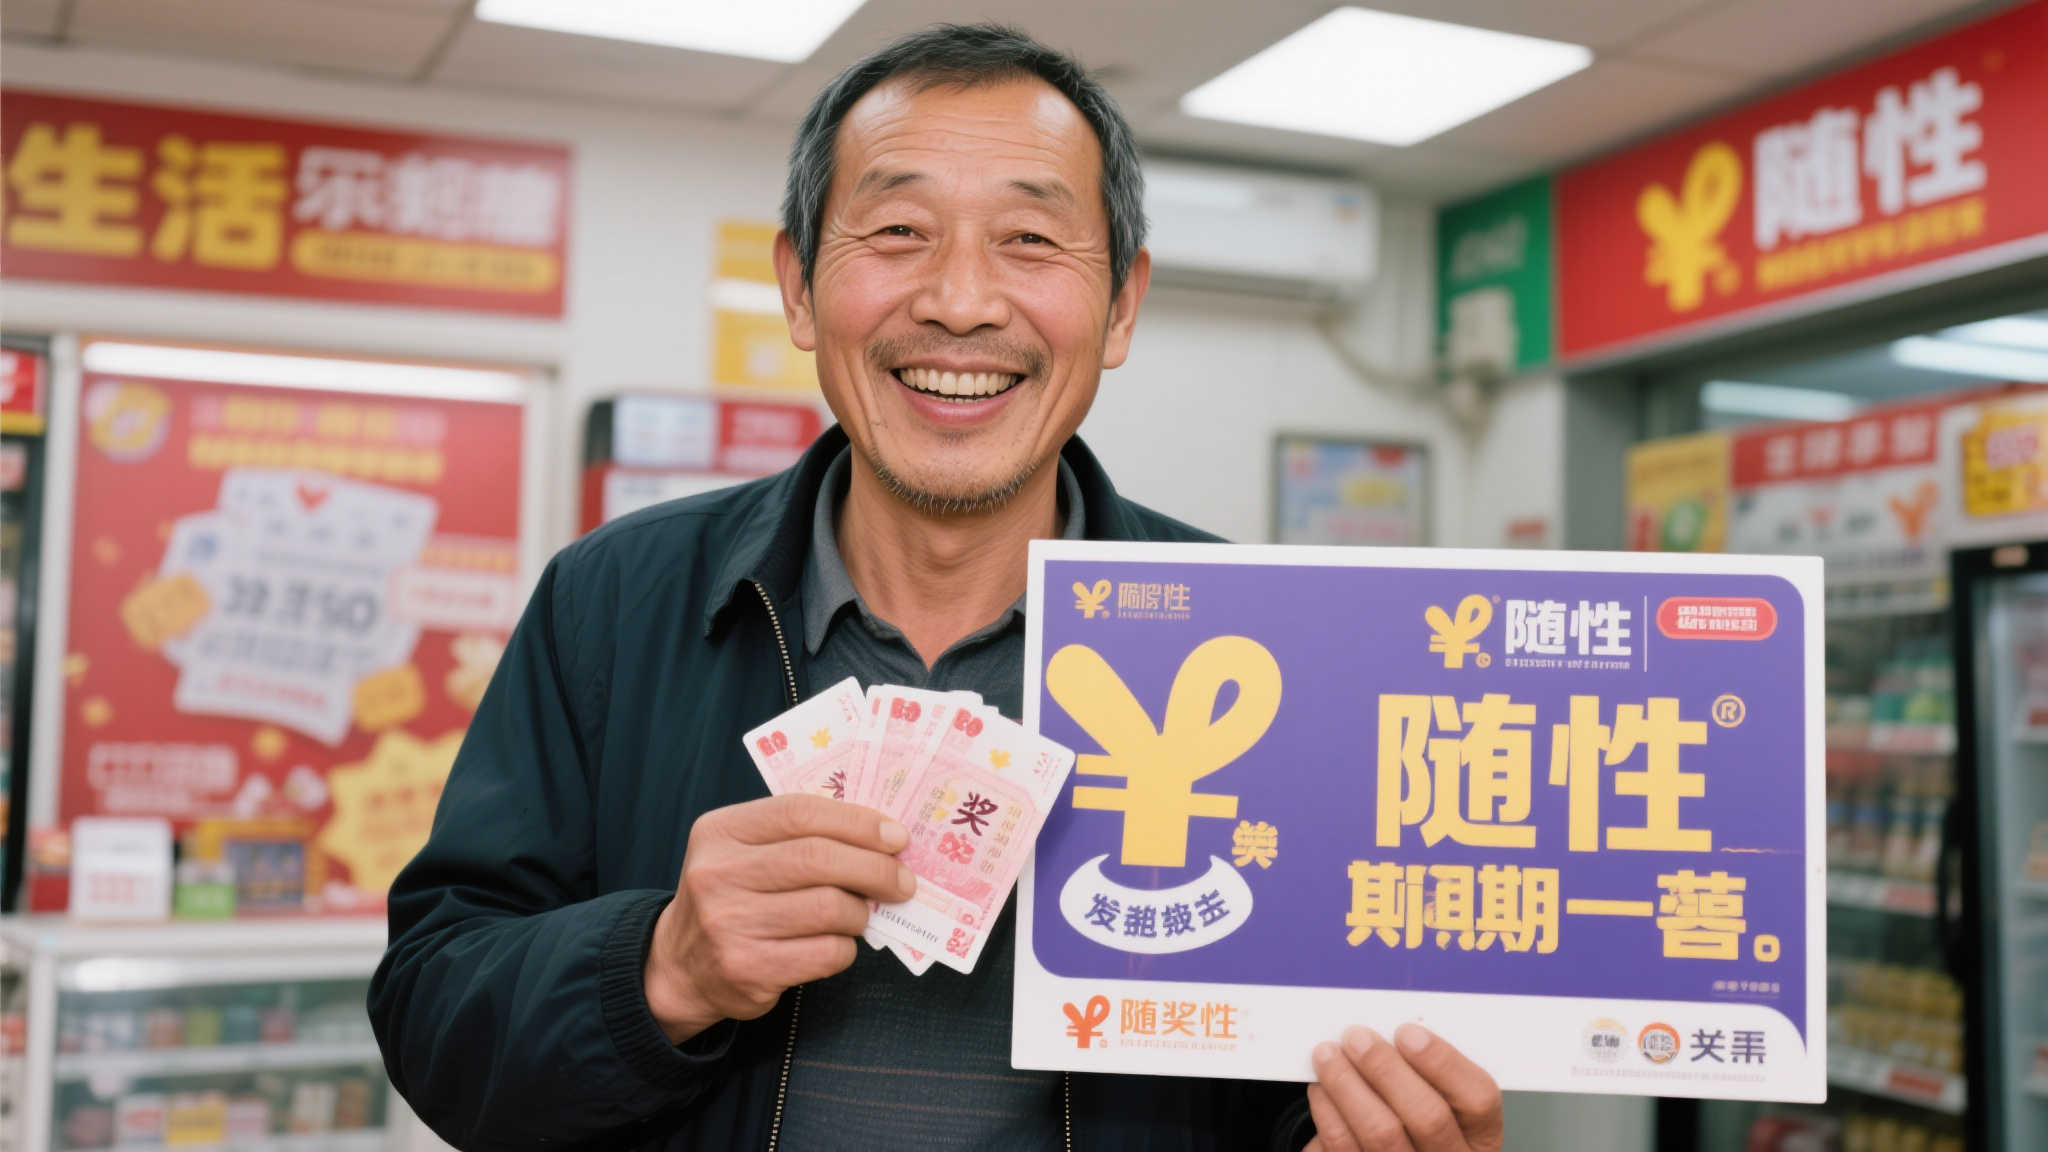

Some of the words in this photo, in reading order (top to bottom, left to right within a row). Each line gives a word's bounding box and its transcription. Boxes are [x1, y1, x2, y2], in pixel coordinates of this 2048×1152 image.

[8, 122, 288, 271] 生活
[1505, 600, 1632, 656] 随性
[1376, 693, 1712, 852] 随性
[1119, 998, 1238, 1040] 随奖性
